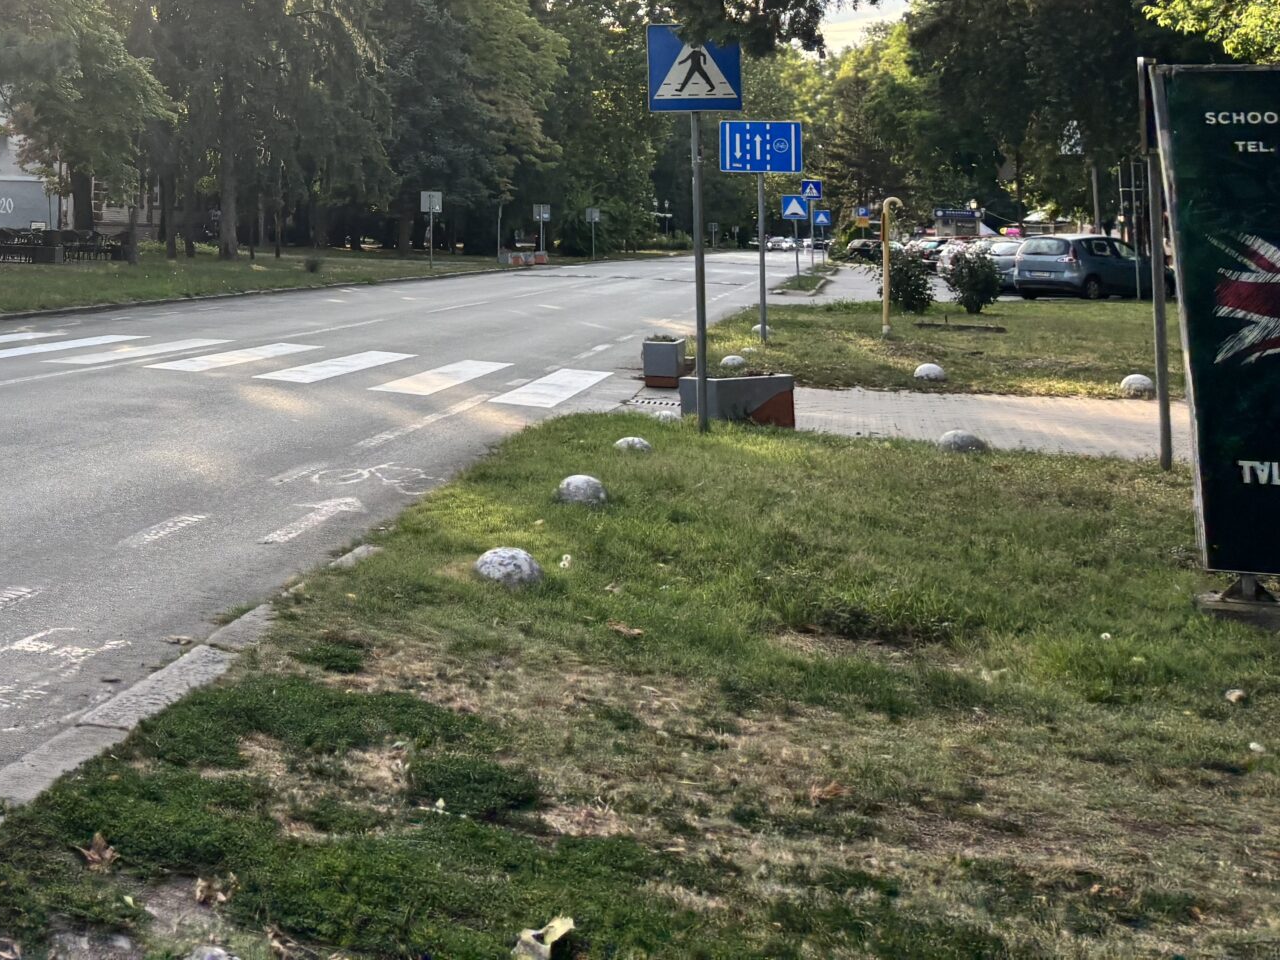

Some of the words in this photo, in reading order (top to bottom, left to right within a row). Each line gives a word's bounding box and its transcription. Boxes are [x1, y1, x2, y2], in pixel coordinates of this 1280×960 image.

[1205, 112, 1279, 125] SCHOO
[1234, 141, 1276, 153] TEL.
[858, 207, 866, 216] P
